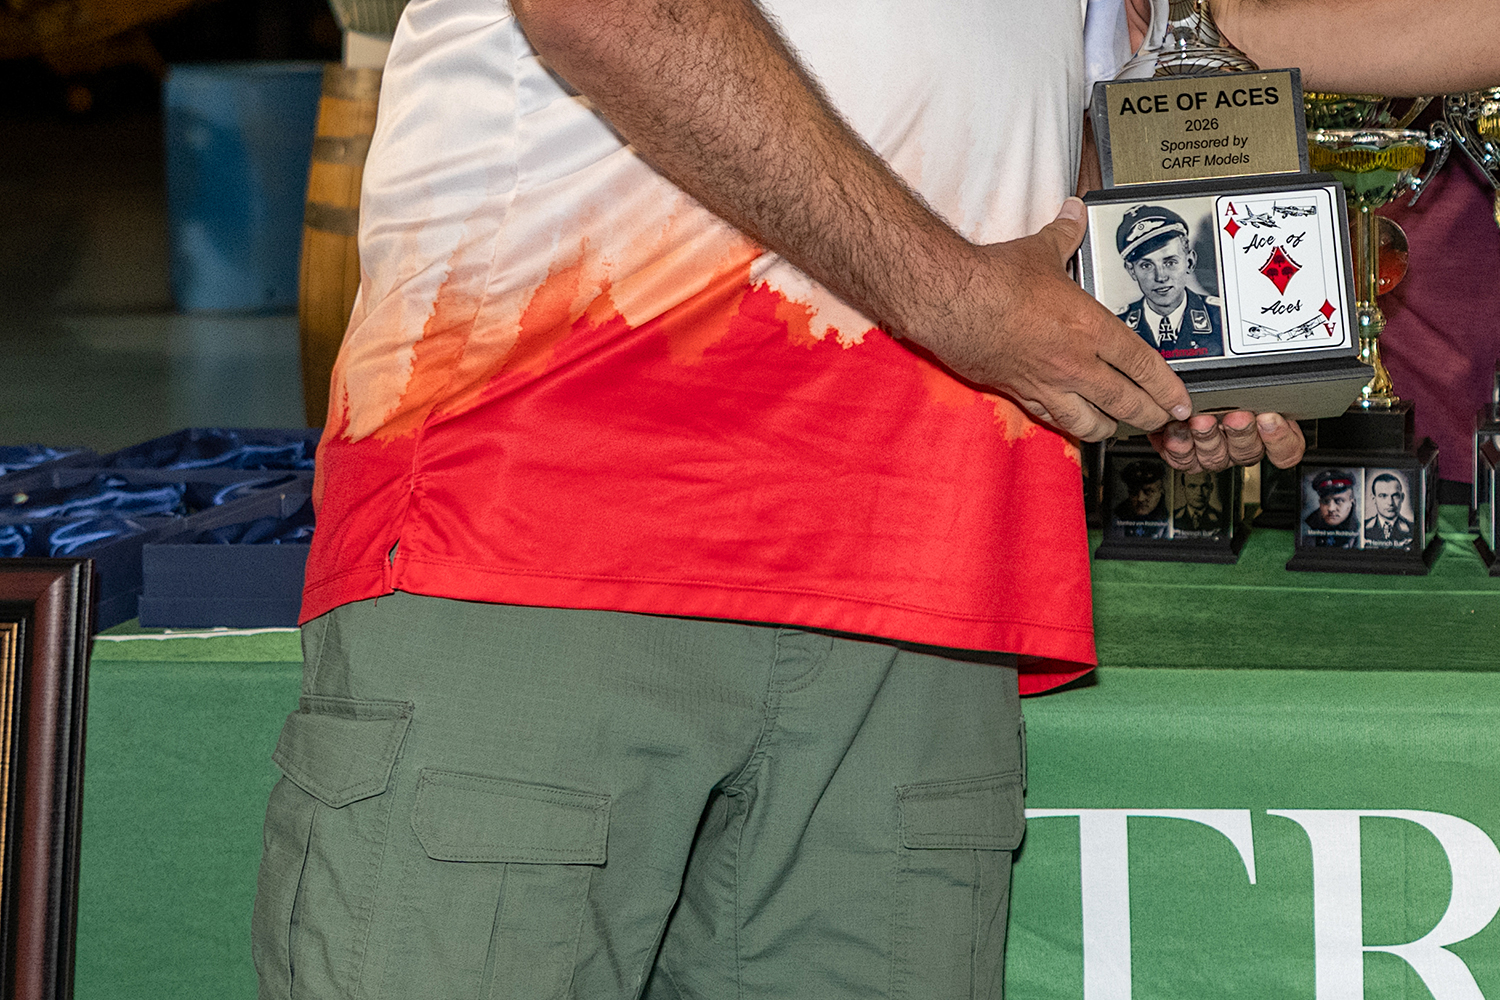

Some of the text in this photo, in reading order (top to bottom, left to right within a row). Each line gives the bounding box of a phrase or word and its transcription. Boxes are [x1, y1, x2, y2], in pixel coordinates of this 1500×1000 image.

[1119, 86, 1279, 116] ACE OF ACES
[1184, 118, 1219, 132] 2026
[1160, 135, 1249, 153] Sponsored by
[1162, 152, 1250, 170] CARF Models
[1224, 201, 1239, 216] A
[1242, 231, 1306, 254] Ace of
[1260, 299, 1303, 316] Aces
[1323, 321, 1337, 338] A
